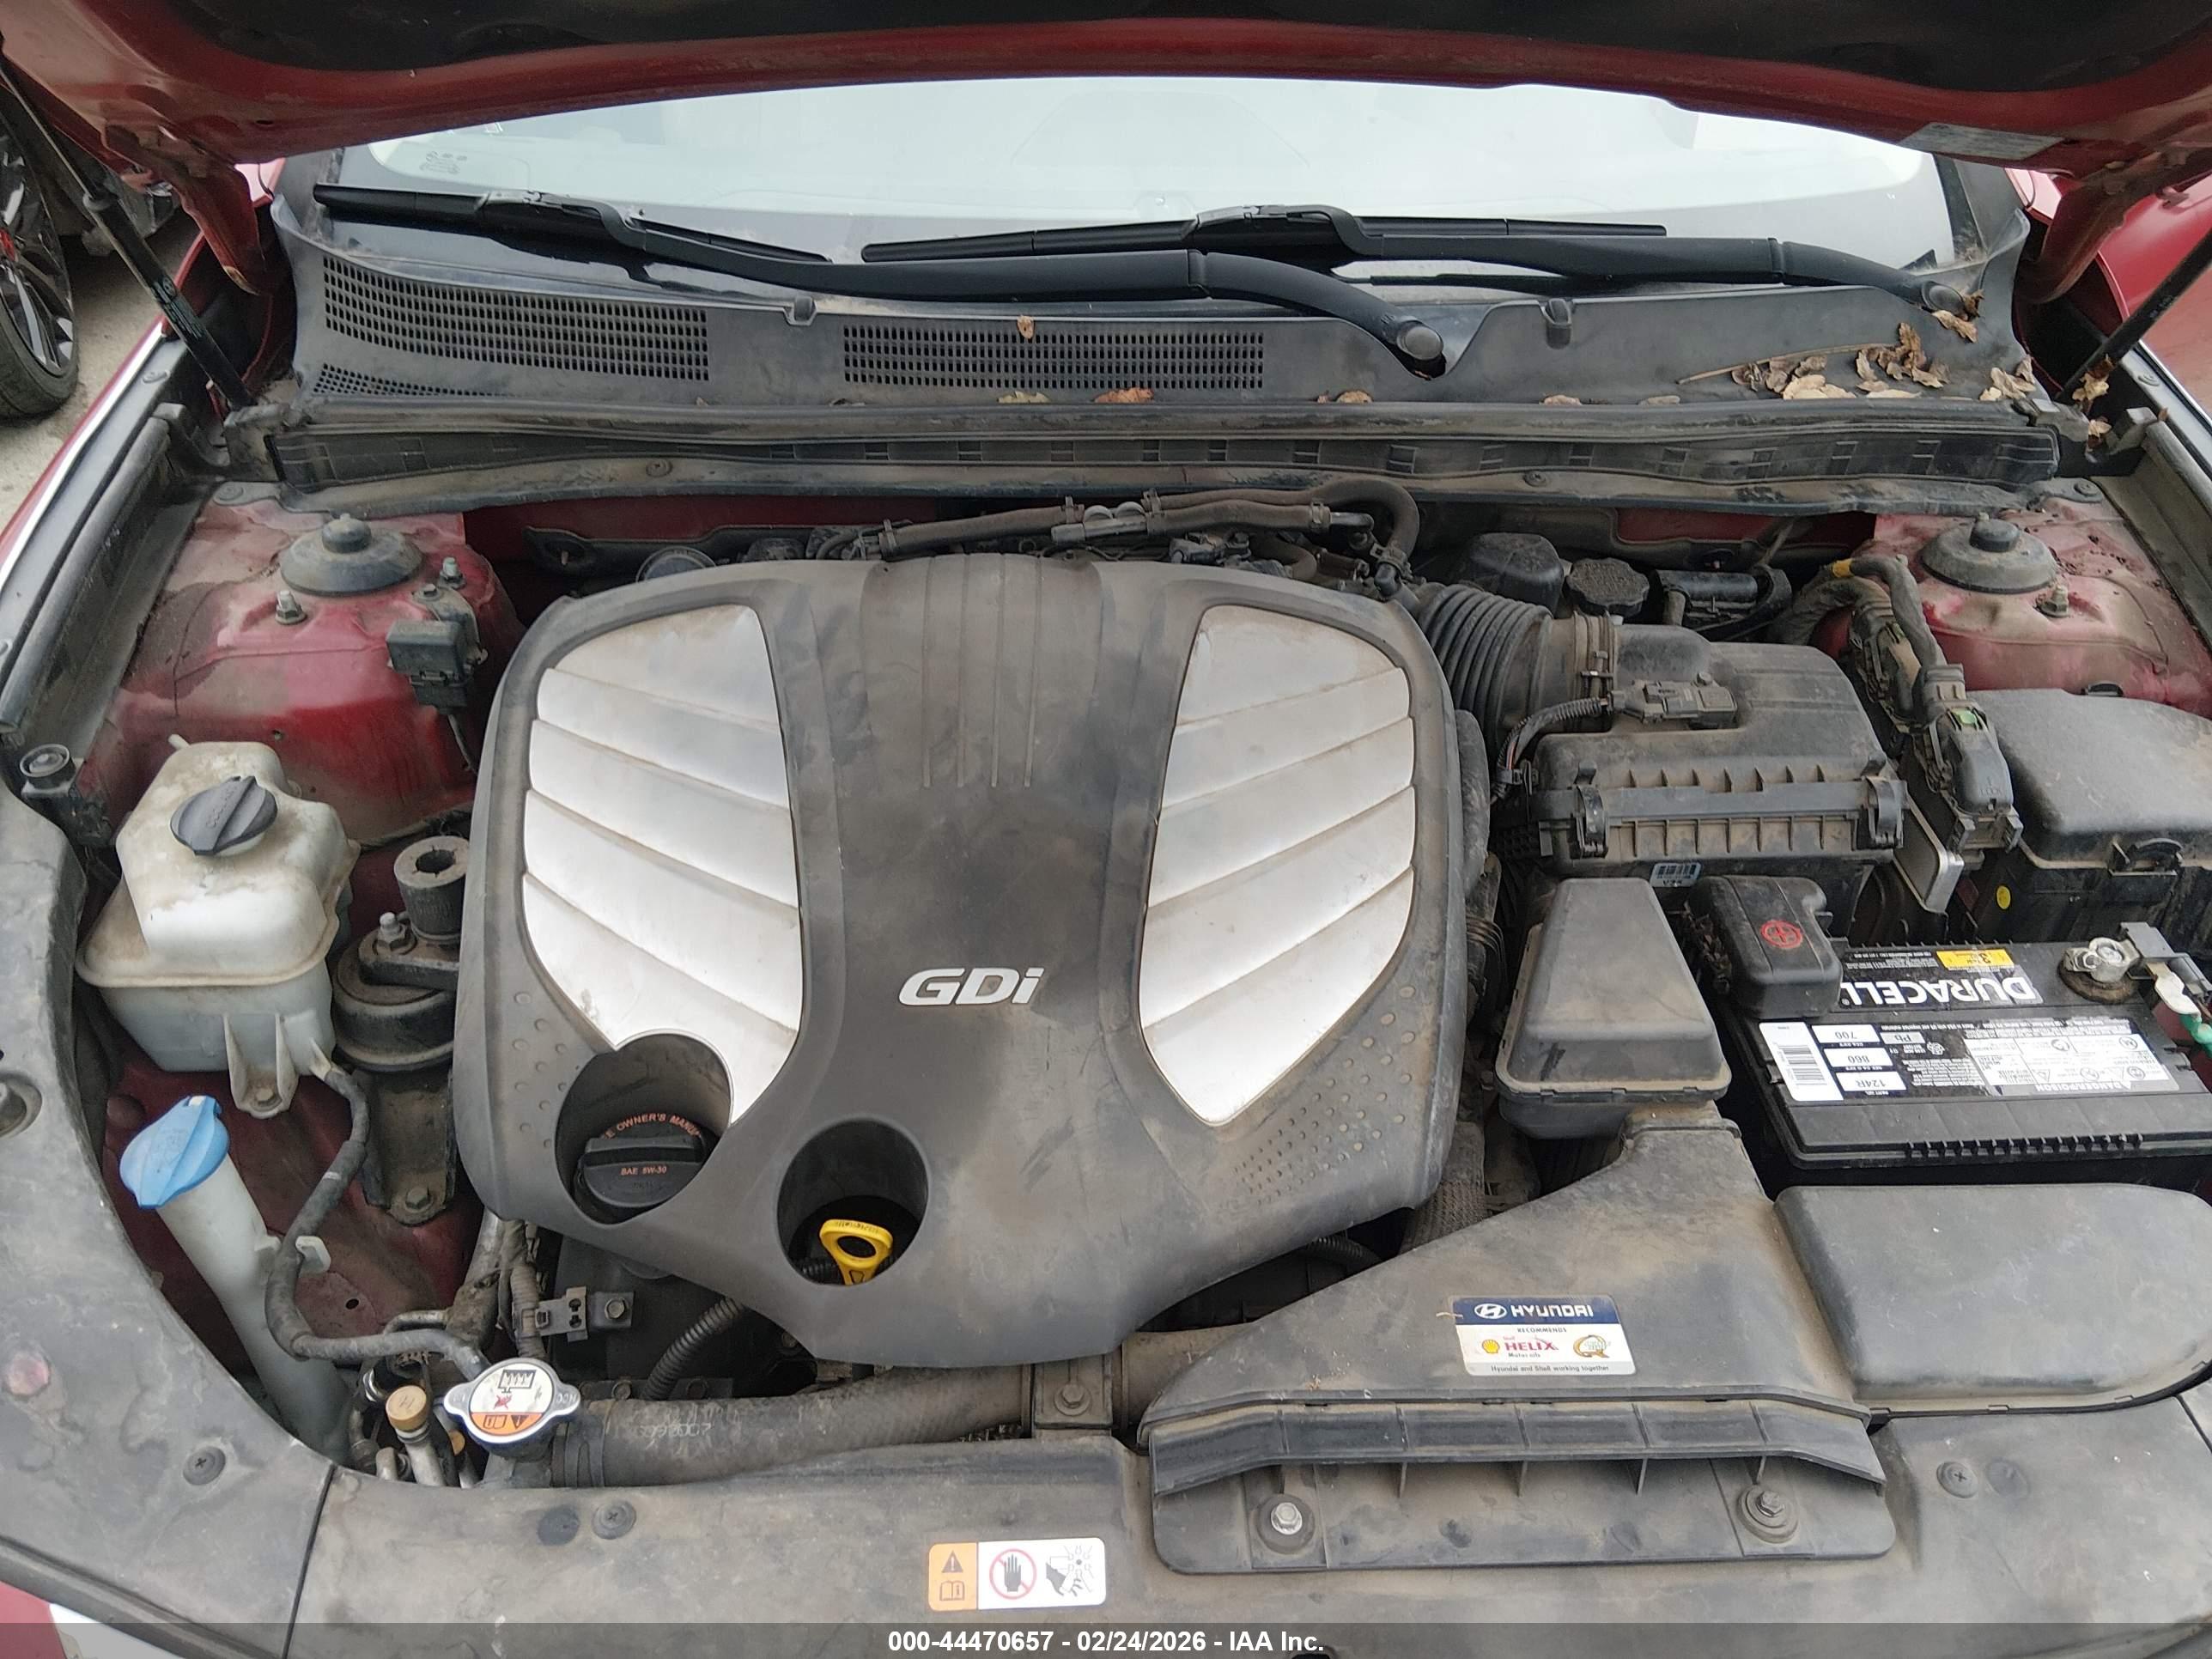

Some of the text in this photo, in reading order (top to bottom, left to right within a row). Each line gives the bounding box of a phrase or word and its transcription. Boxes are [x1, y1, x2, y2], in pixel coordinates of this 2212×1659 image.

[899, 968, 1045, 1006] GDi
[1840, 976, 2036, 1006] DURACELL
[1834, 1030, 1857, 1040] 700
[1894, 1034, 1912, 1042] Pb
[1856, 1079, 1887, 1089] 124R
[617, 1113, 667, 1132] OWNER'S
[1510, 1304, 1595, 1317] HYUNDAI
[1504, 1341, 1559, 1351] HELIX
